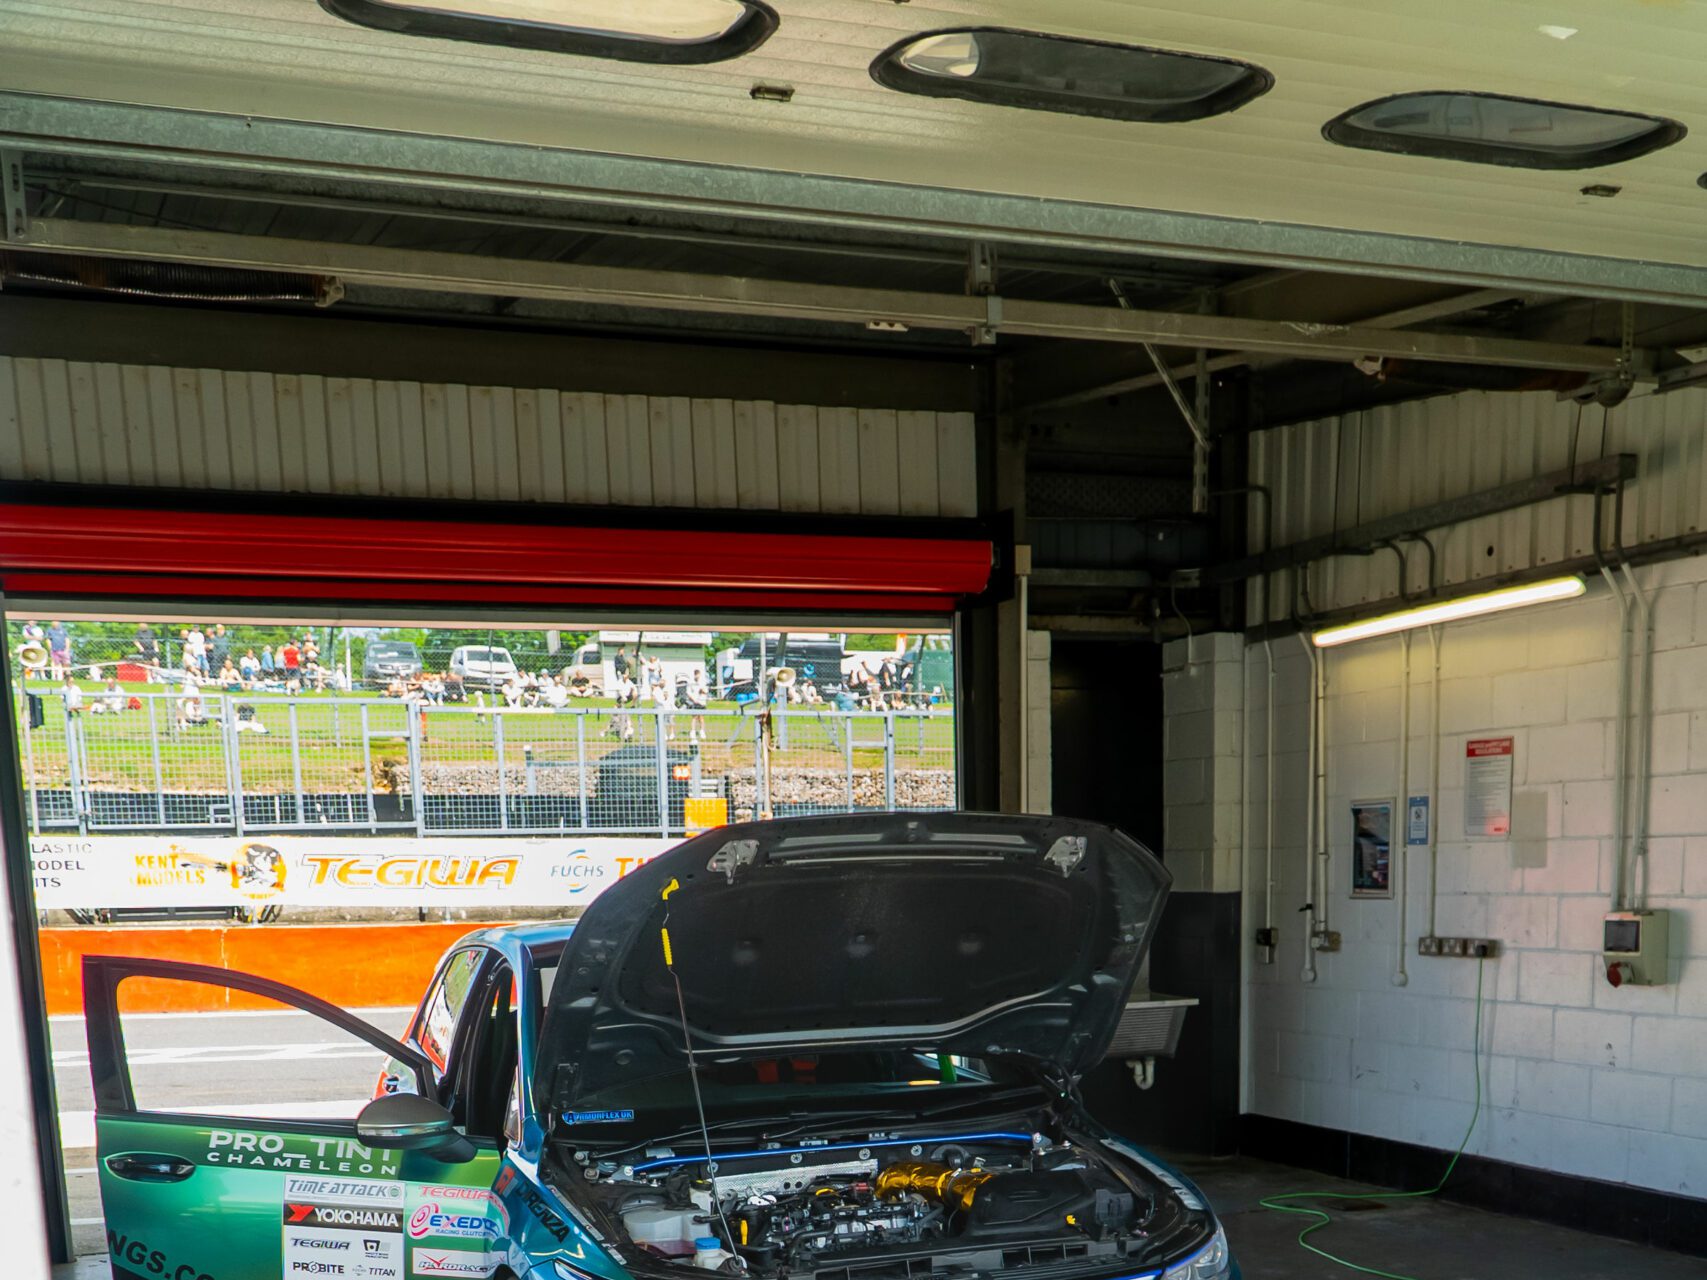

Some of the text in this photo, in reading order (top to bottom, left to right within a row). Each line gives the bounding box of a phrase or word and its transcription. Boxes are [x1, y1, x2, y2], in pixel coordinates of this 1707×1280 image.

[135, 854, 178, 869] KENT
[305, 857, 521, 887] TEGIWA
[551, 865, 604, 877] FUCHS
[207, 1153, 396, 1175] CHAMELEON
[331, 1181, 388, 1197] ATTACK
[314, 1208, 399, 1227] YOKOHAMA
[291, 1238, 350, 1250] TEGIWA
[293, 1261, 345, 1274] PROBITE
[369, 1267, 396, 1276] TITAN
